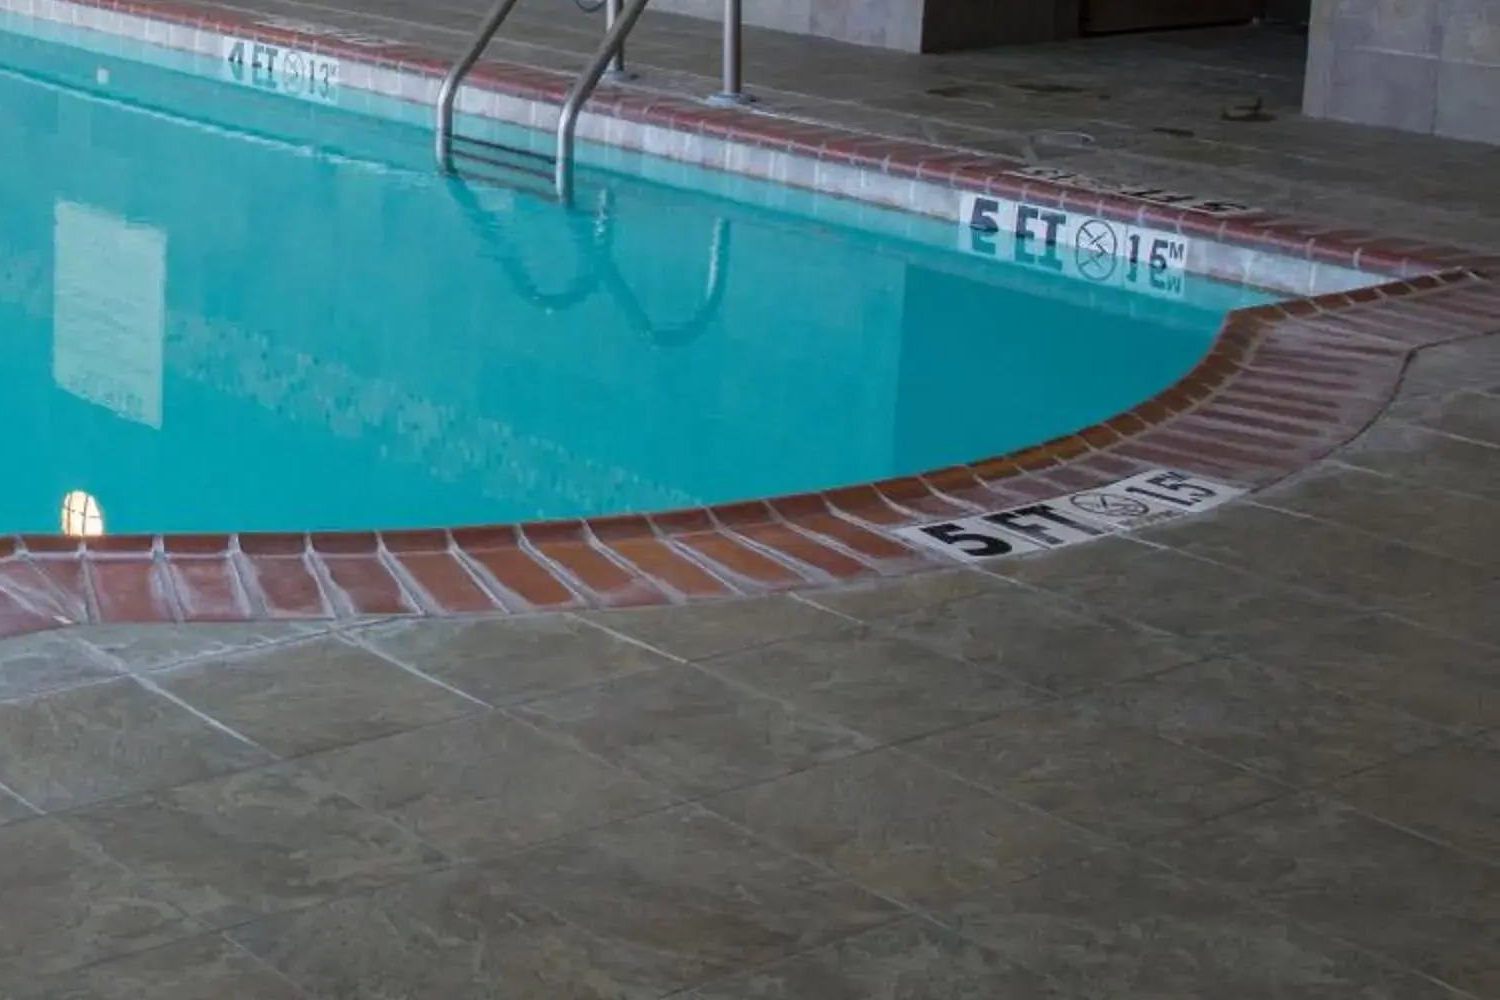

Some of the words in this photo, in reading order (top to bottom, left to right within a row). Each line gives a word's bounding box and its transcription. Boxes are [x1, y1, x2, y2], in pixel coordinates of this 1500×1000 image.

[969, 198, 999, 233] 5
[1015, 205, 1067, 246] FT
[919, 523, 1013, 557] 5
[981, 503, 1105, 546] FT
